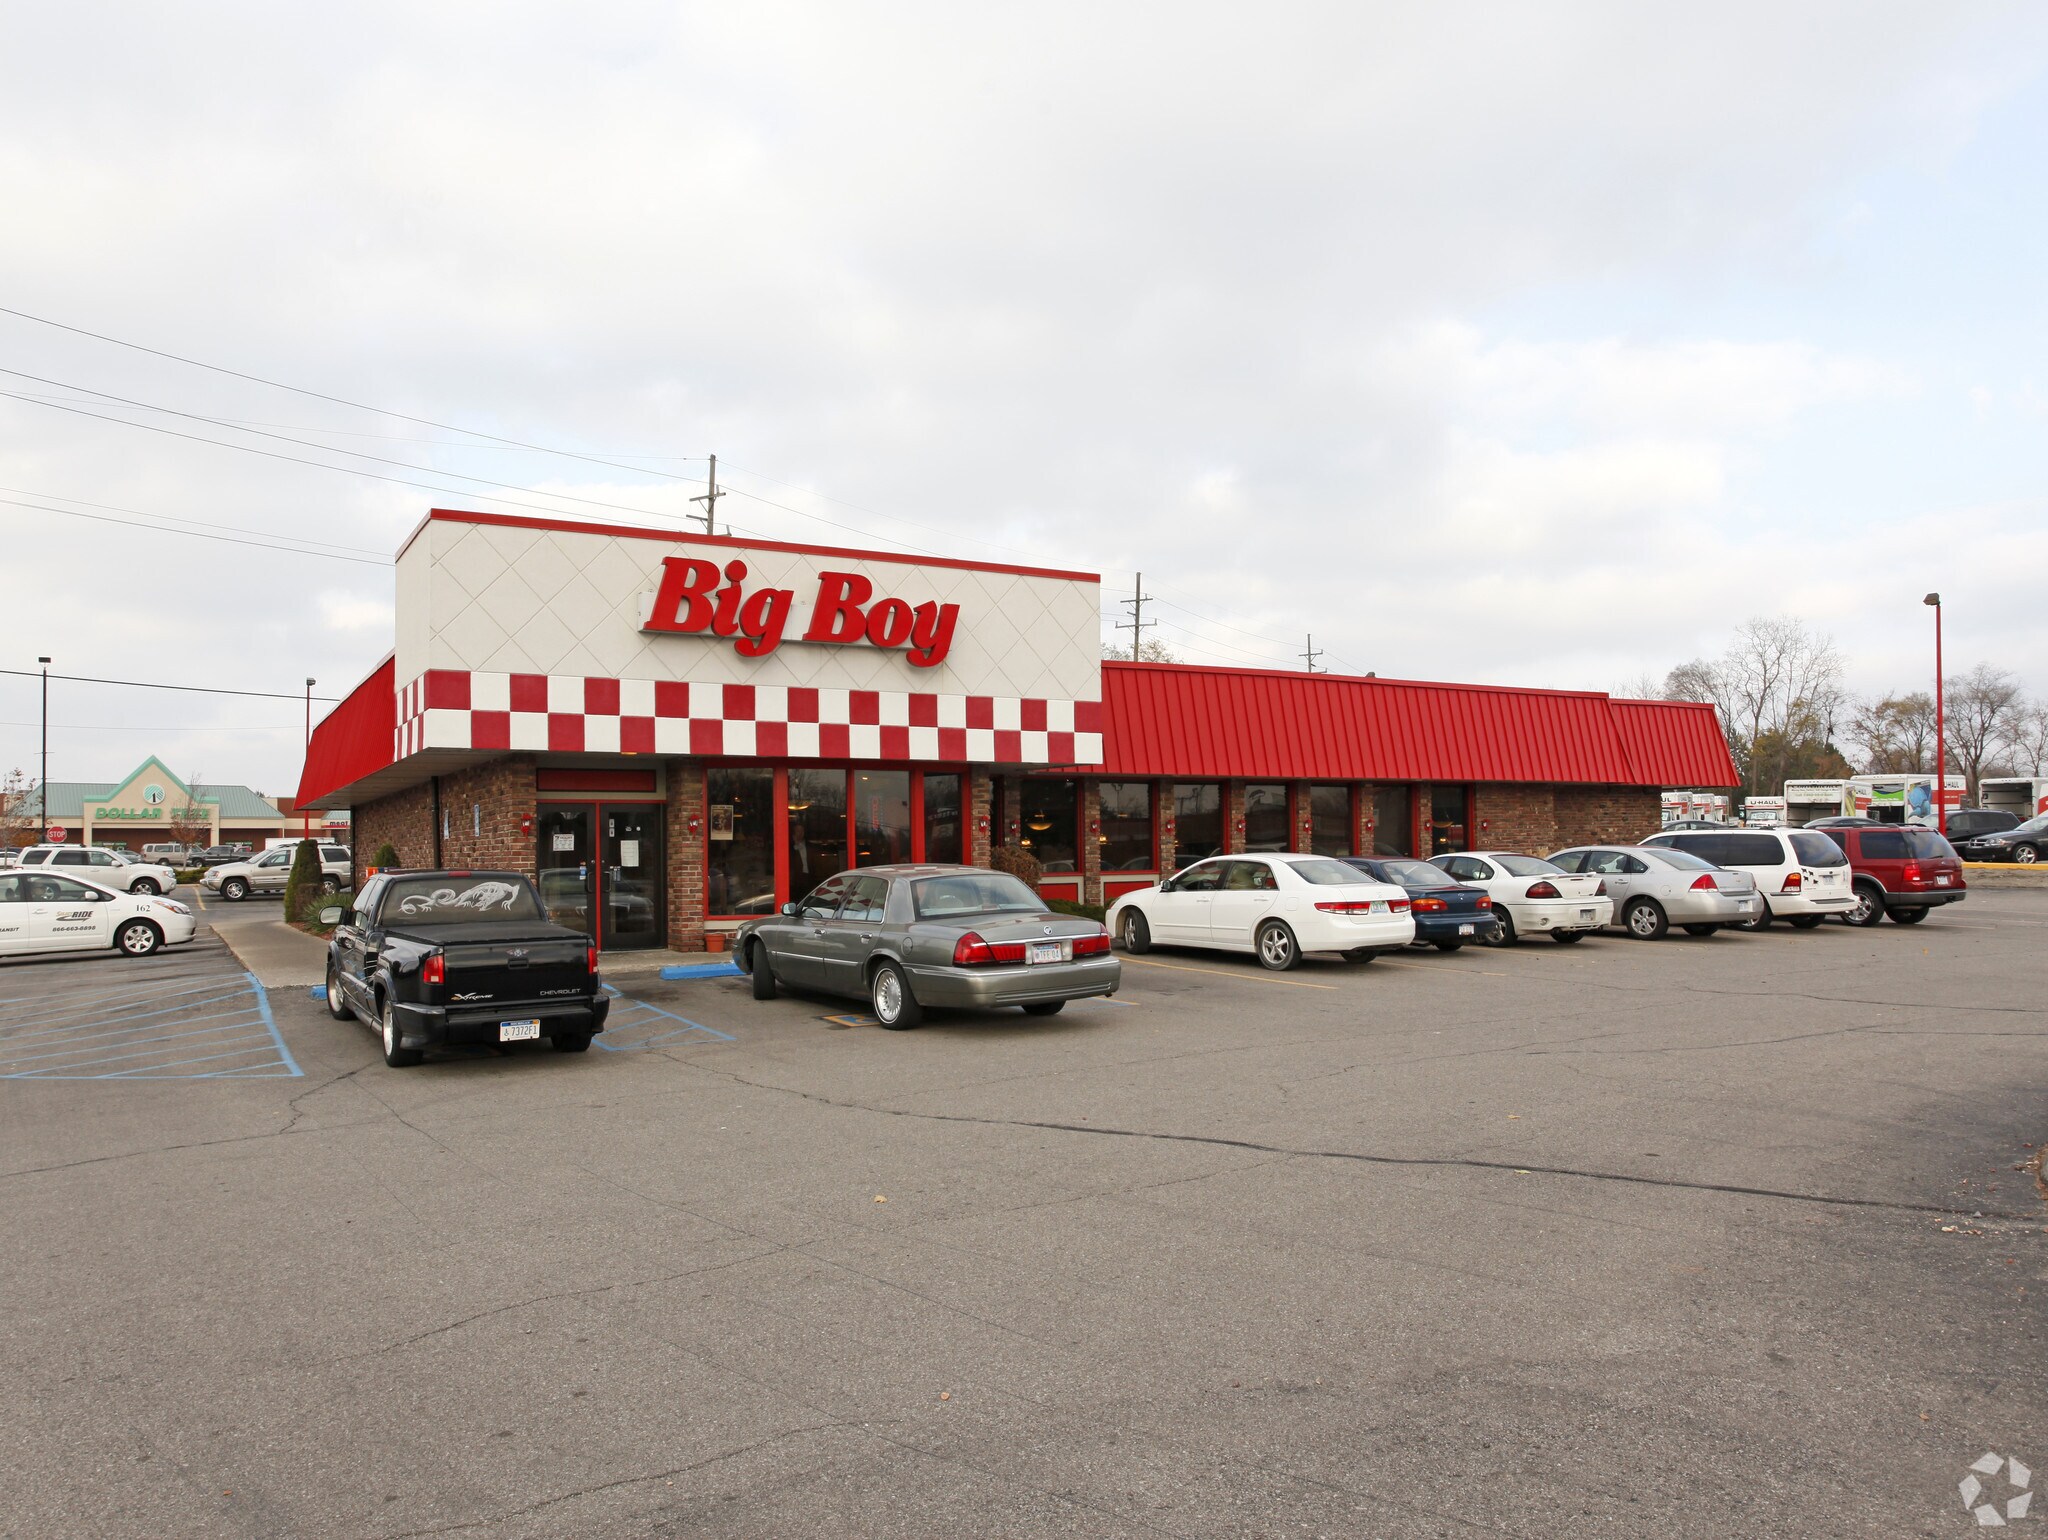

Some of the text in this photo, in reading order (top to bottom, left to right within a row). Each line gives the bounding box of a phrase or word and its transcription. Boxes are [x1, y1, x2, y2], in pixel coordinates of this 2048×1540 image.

[643, 556, 960, 667] Big Boy
[95, 807, 162, 819] DOLLAR
[540, 988, 581, 996] CHEVROLET
[511, 1025, 537, 1037] 7372F1
